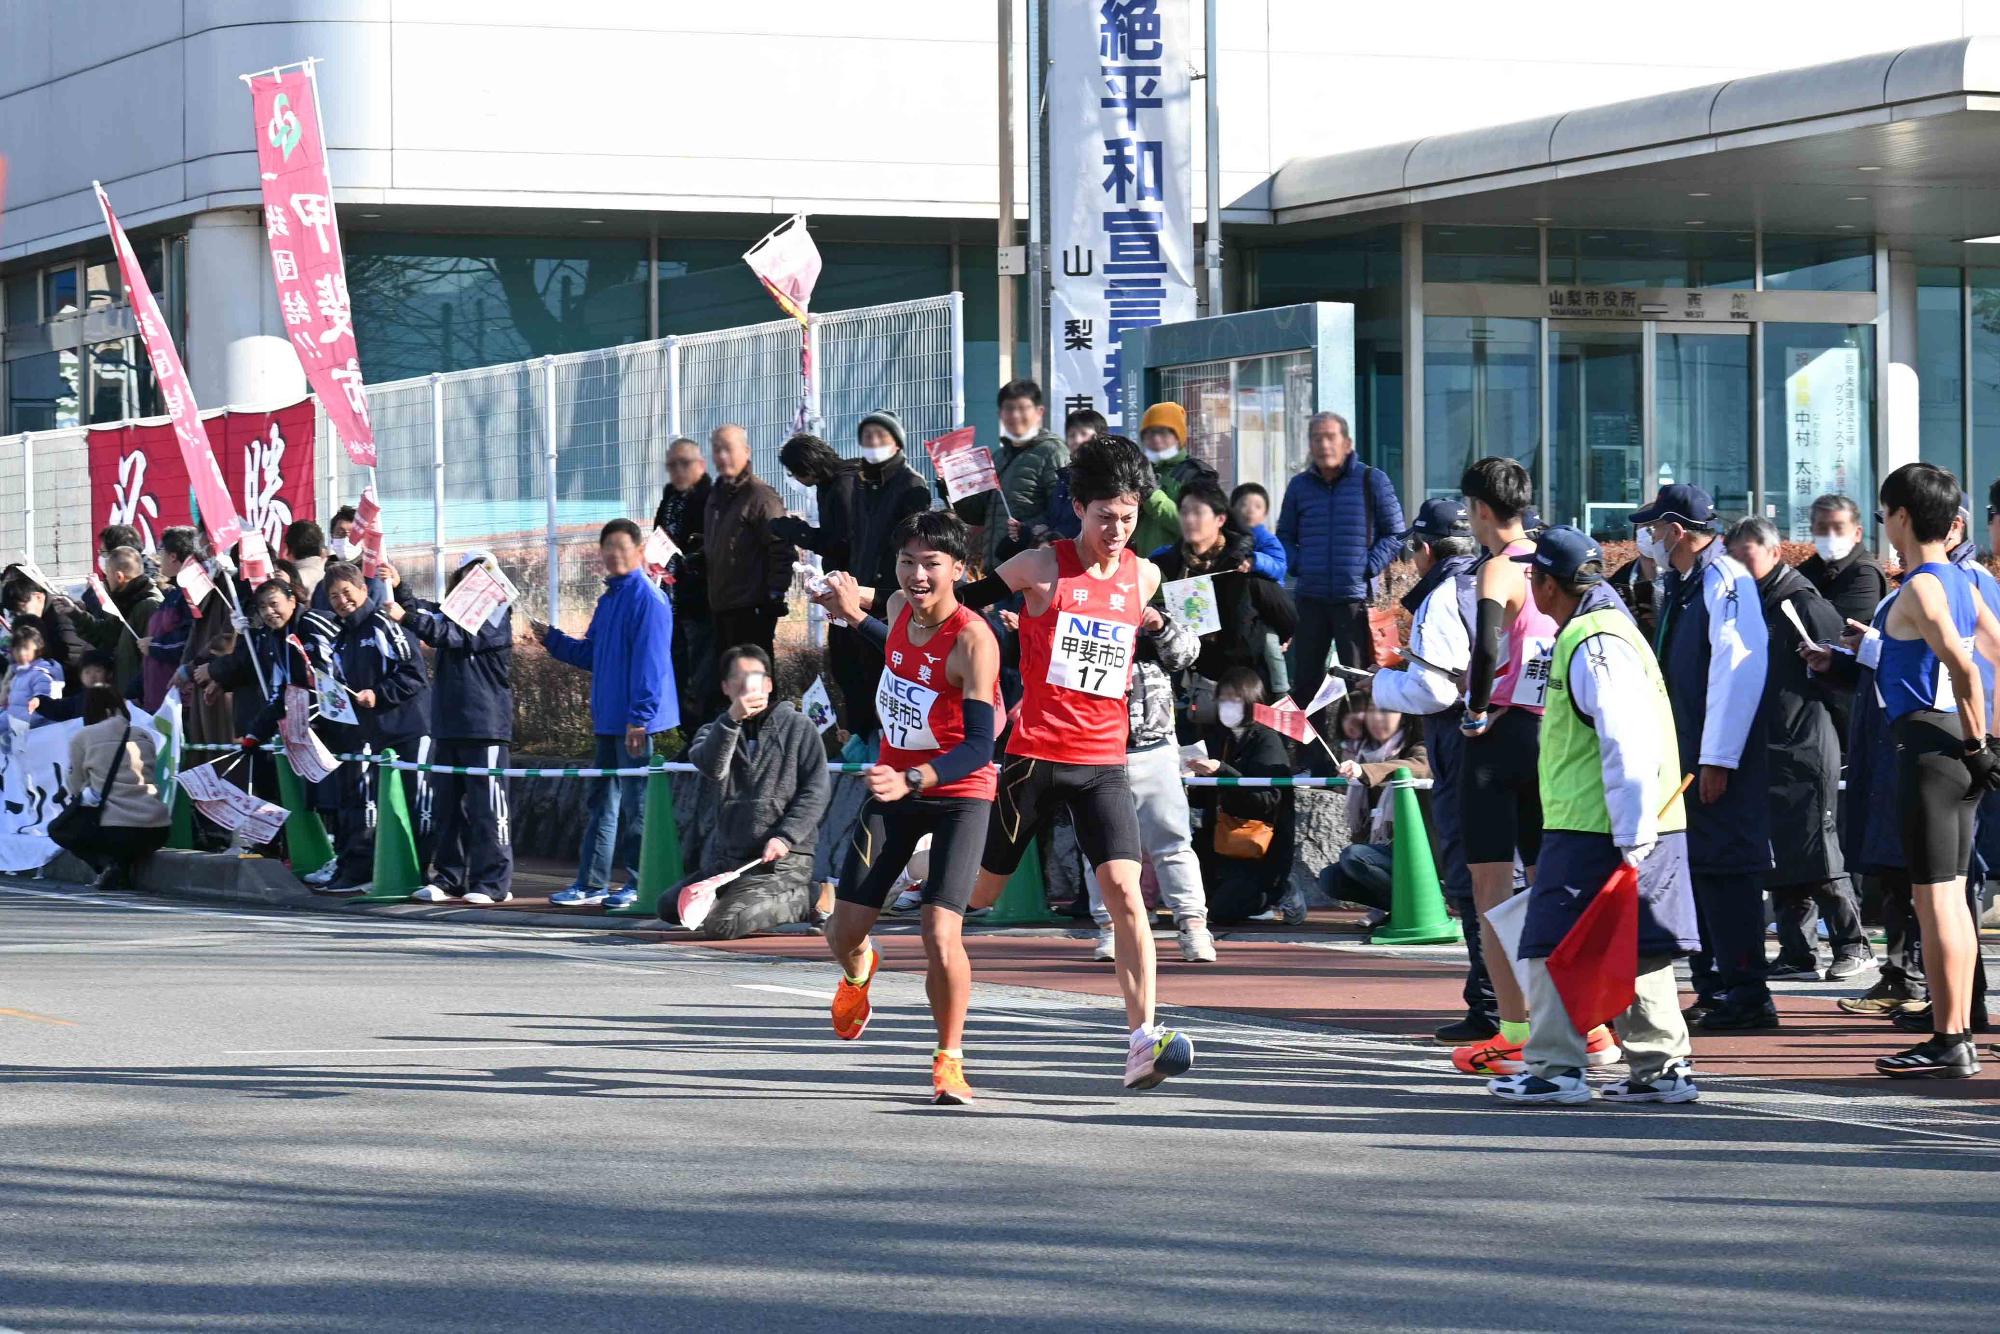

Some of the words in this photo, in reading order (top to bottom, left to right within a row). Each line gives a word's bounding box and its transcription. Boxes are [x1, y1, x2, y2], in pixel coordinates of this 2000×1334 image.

[1549, 290, 1637, 308] 山梨市役所
[1069, 617, 1127, 643] NEC
[1061, 636, 1127, 669] 甲斐市B
[883, 671, 926, 706] NEC
[1078, 666, 1108, 692] 17
[879, 689, 923, 731] 甲斐市B
[888, 722, 908, 748] 17
